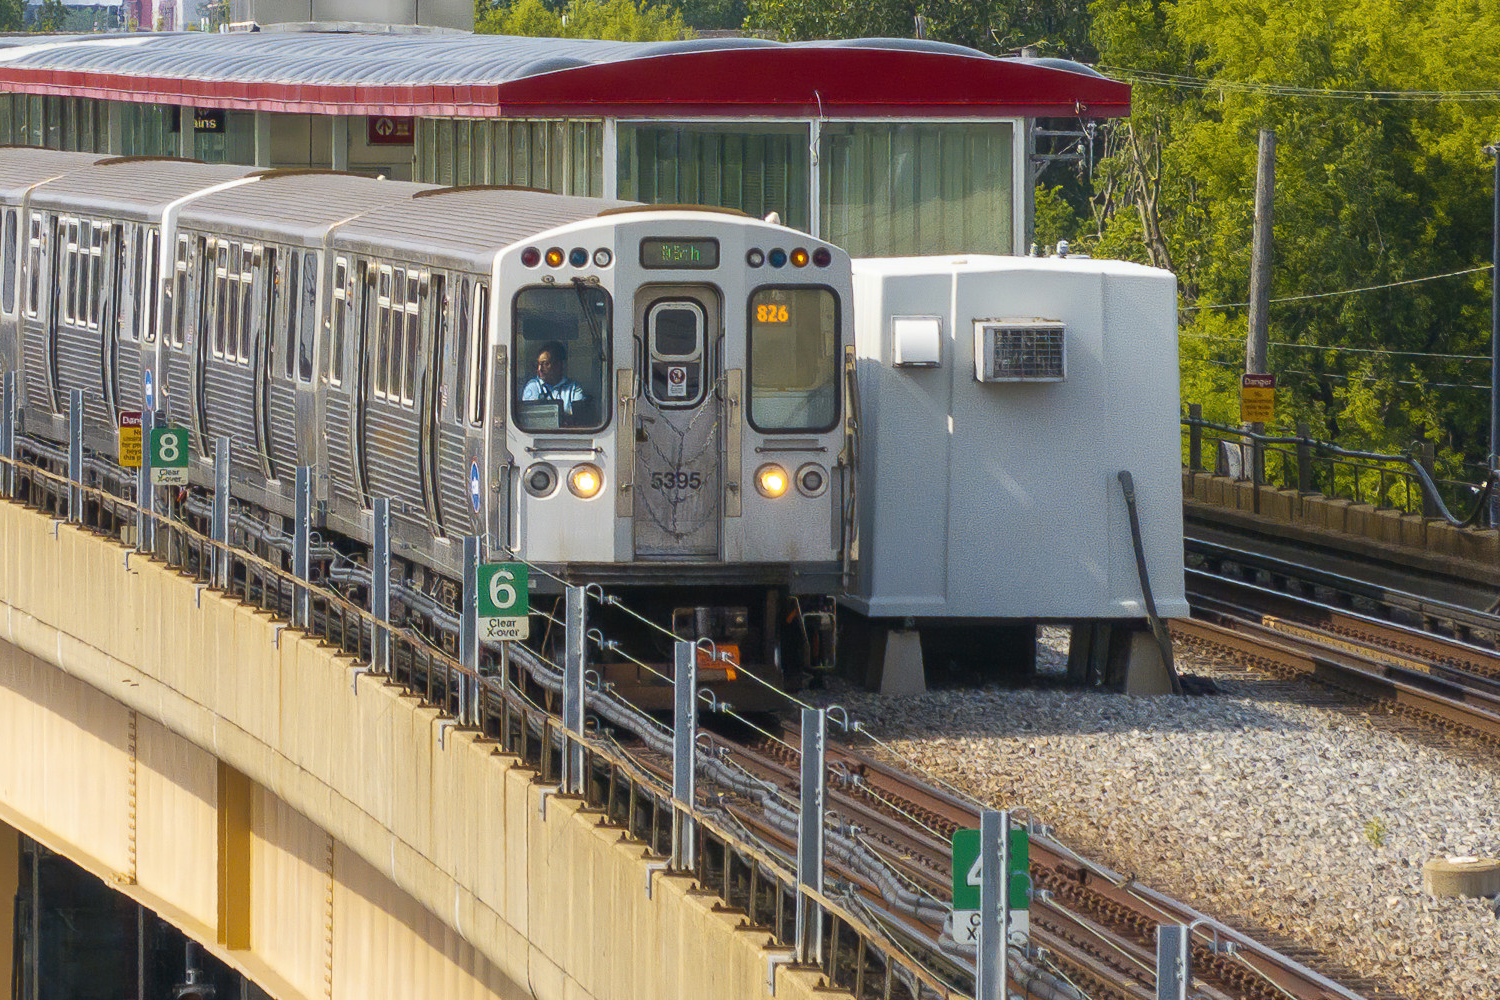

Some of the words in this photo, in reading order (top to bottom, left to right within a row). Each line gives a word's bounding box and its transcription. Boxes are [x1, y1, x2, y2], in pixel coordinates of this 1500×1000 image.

[194, 117, 217, 128] ains
[757, 304, 789, 322] 826
[160, 433, 179, 461] 8
[651, 472, 701, 490] 5395
[489, 570, 517, 609] 6
[487, 627, 520, 637] X-over
[489, 618, 517, 628] Clear
